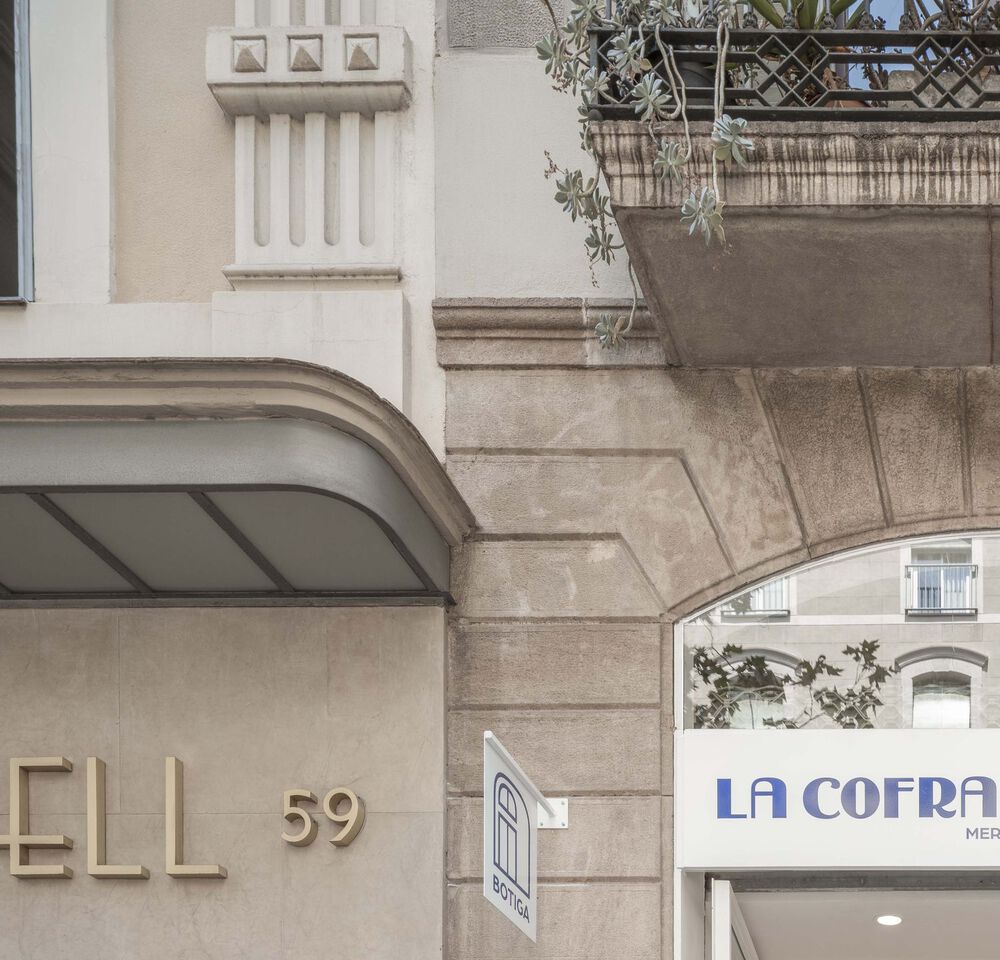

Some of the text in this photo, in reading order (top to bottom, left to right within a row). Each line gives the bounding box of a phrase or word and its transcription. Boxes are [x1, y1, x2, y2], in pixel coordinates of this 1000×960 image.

[0, 756, 366, 880] ELL 59
[716, 777, 788, 819] LA
[492, 874, 530, 923] BOTIGA
